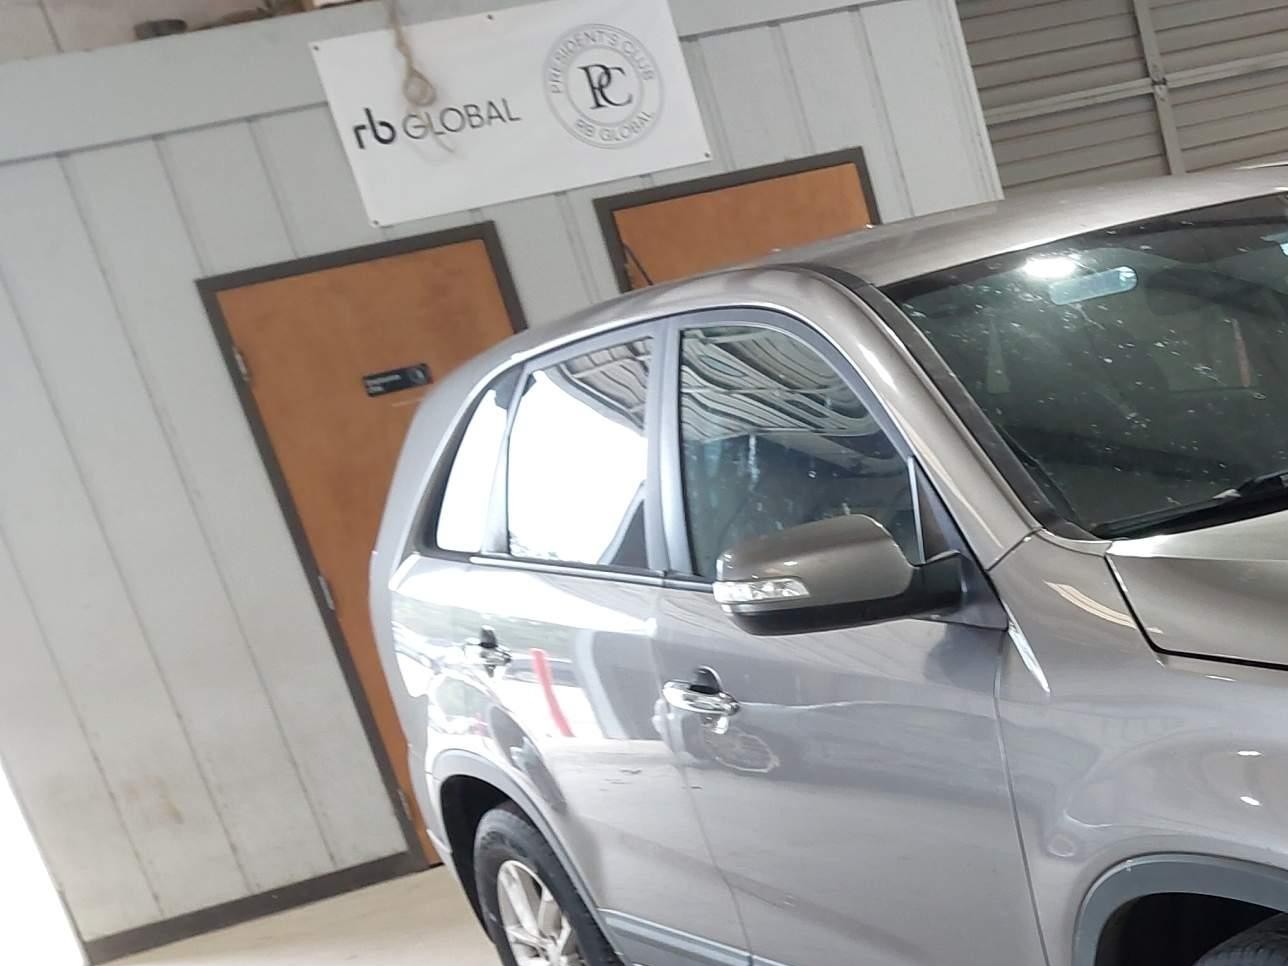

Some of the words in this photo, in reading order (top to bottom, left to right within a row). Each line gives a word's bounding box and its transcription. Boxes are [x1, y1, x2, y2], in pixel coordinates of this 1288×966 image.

[622, 40, 655, 81] CLUB
[353, 107, 396, 149] rb
[402, 97, 521, 140] GLOBAL
[576, 118, 595, 138] RB
[599, 110, 654, 142] GLOBAL
